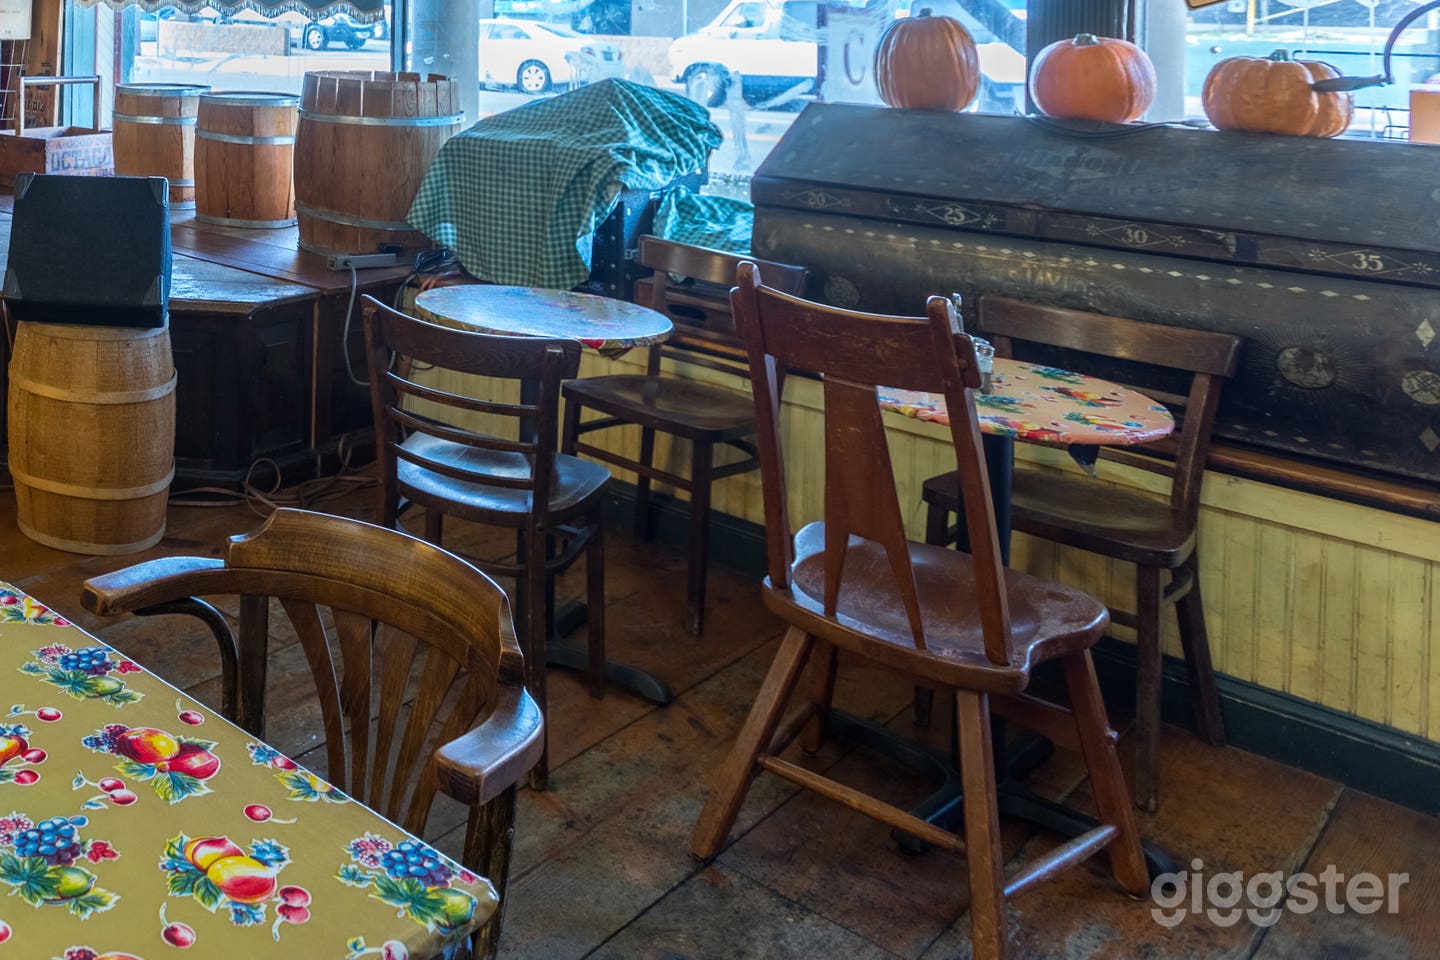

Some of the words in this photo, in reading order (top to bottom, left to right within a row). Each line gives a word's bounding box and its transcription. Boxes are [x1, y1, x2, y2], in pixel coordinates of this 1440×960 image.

[806, 191, 828, 207] 20
[943, 206, 965, 225] 25
[1122, 227, 1148, 245] 30
[1352, 251, 1385, 272] 35
